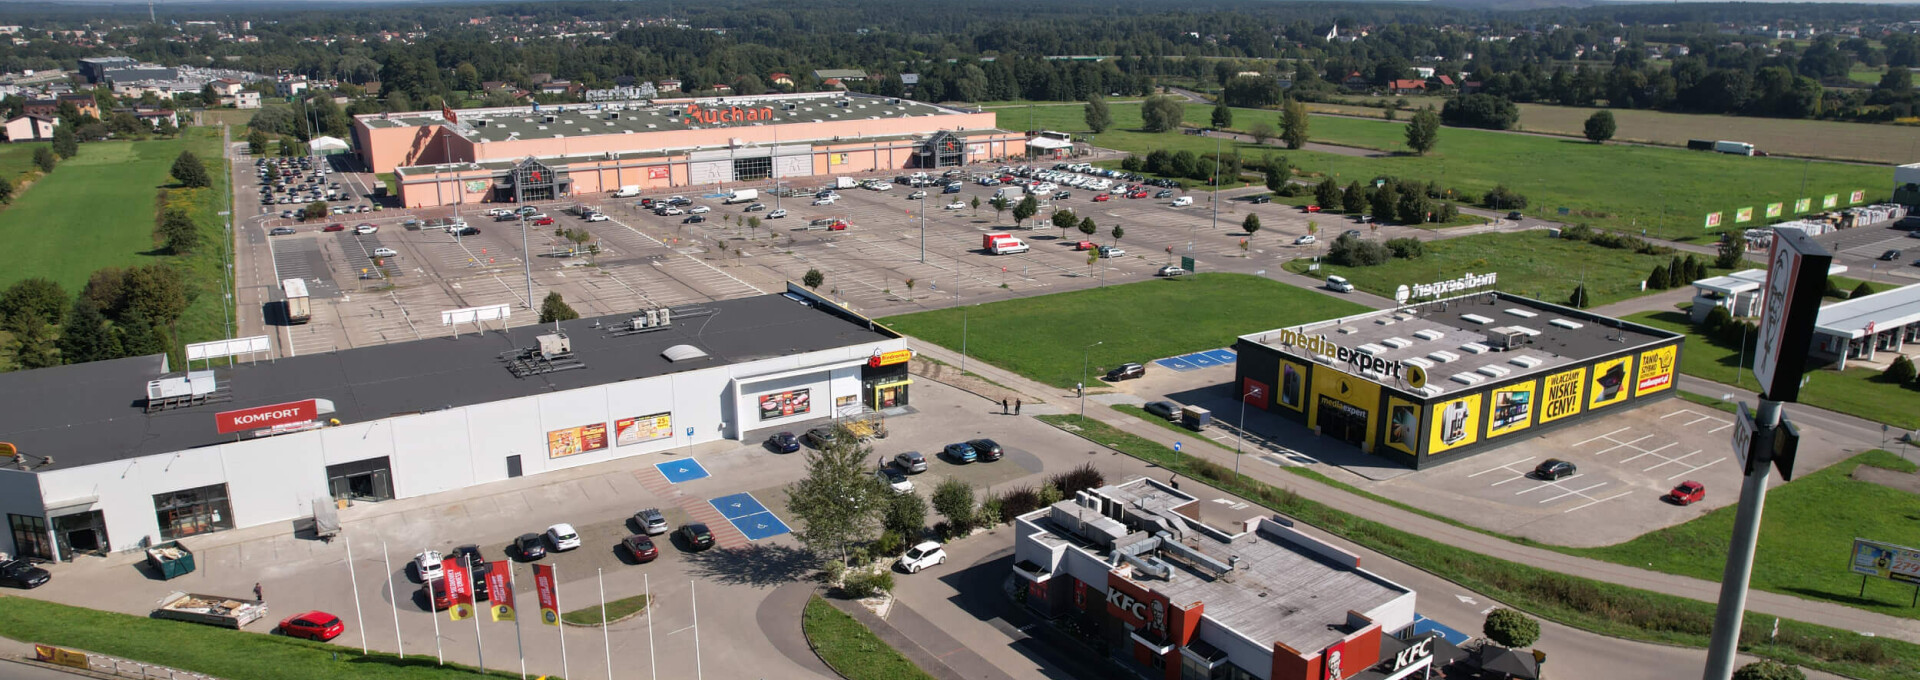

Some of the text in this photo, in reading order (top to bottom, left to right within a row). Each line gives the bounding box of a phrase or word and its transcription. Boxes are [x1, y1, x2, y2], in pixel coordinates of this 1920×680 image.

[684, 104, 773, 125] Auchan
[1280, 328, 1403, 379] mediaexpert
[1549, 381, 1578, 401] NISKIE
[234, 408, 300, 425] KOMFORT
[1321, 398, 1366, 418] mediaexpert
[1547, 396, 1576, 418] CENY!
[1106, 586, 1146, 620] KFC
[1393, 636, 1432, 671] KFC
